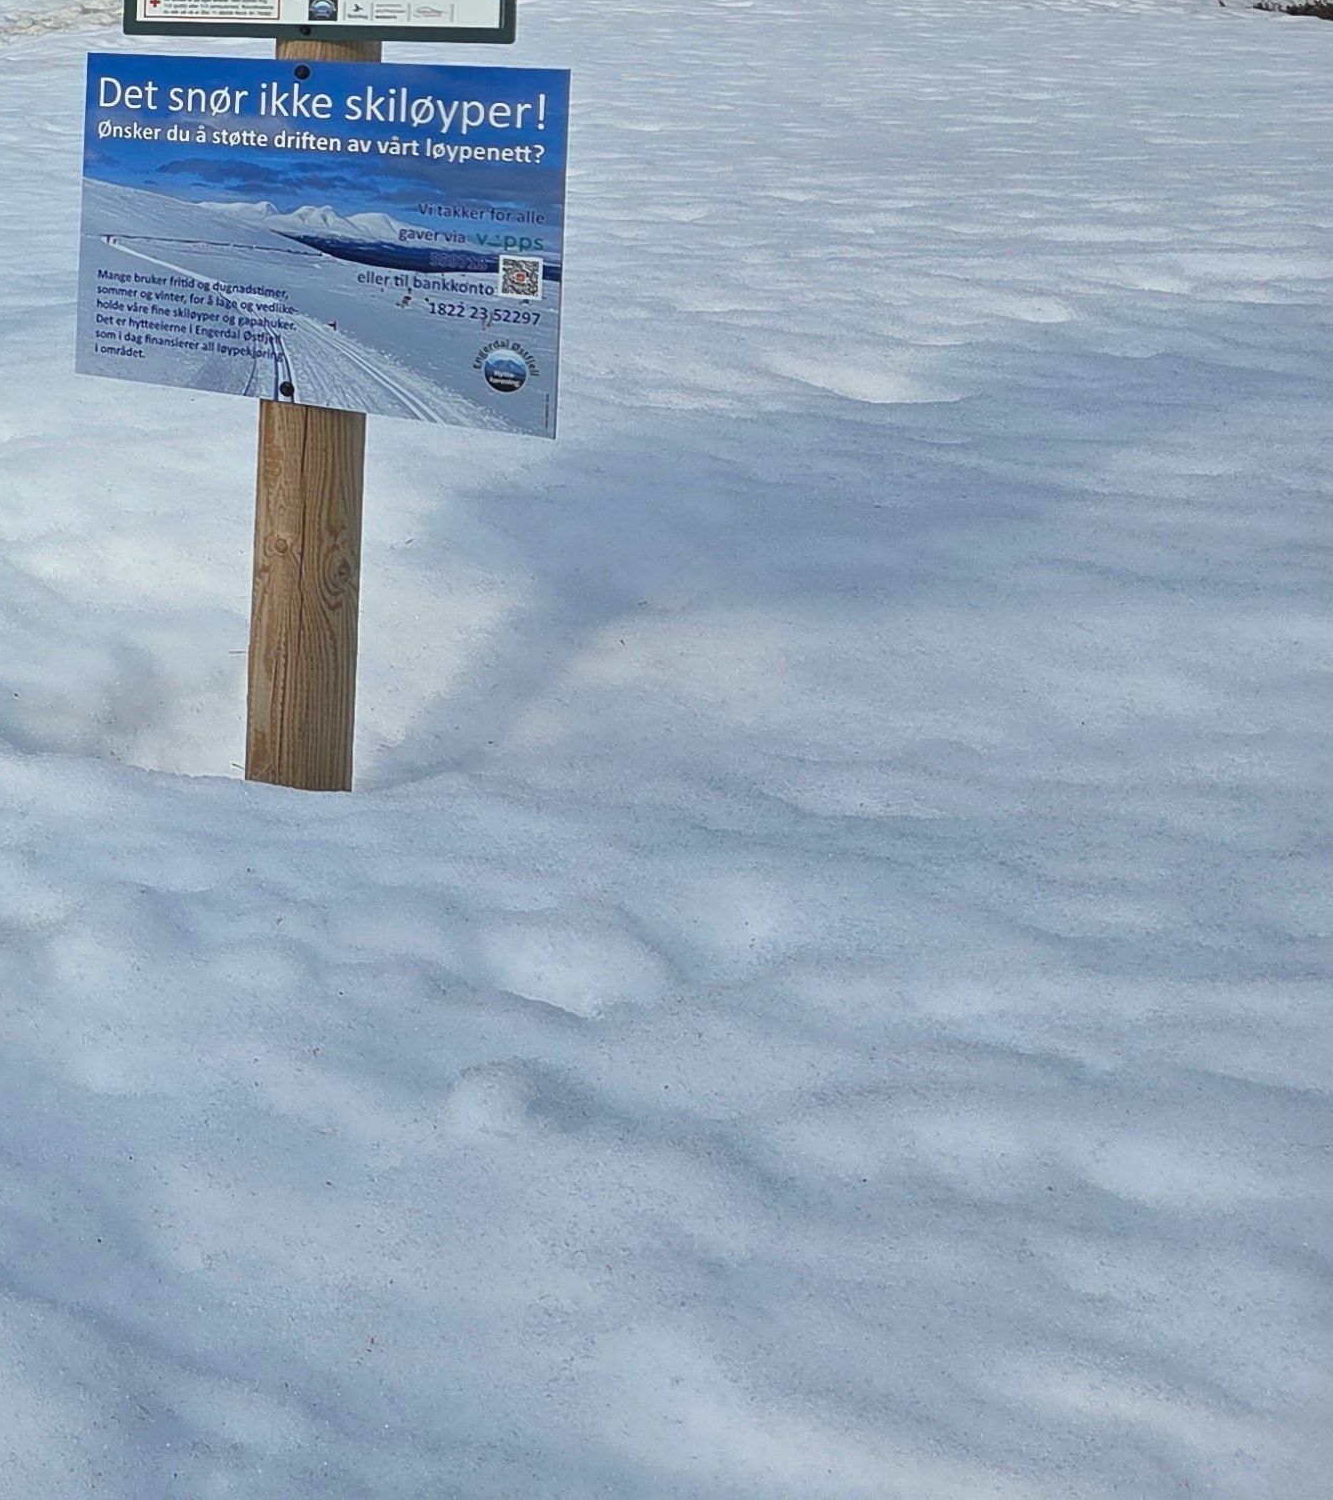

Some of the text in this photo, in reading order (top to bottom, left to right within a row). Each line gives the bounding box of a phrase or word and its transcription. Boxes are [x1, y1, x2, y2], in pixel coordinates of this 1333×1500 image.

[98, 76, 546, 135] Det snør ikke skiløyper!
[97, 118, 545, 164] Ønsker du å støtte driften av vårt løypenett?
[418, 203, 545, 225] Vi takker for alle
[398, 228, 440, 242] gaver
[444, 231, 466, 244] via
[98, 269, 289, 300] Mange bruker fritid og dugnadstimer,
[357, 271, 390, 287] eller
[394, 274, 409, 287] til
[97, 286, 138, 297] sommer
[140, 290, 153, 301] og
[155, 290, 187, 304] vinter,
[189, 293, 204, 304] for
[207, 295, 213, 305] å
[216, 296, 238, 309] lage
[240, 302, 253, 312] og
[96, 299, 297, 331] holde våre fine skiløyper og gapahuker.
[96, 314, 114, 325] Det
[116, 318, 126, 326] er
[128, 317, 187, 332] hytteeierne
[195, 325, 240, 339] Engerdal
[429, 302, 541, 326] 1822 23 52297
[95, 330, 116, 339] som
[124, 332, 143, 345] dag
[145, 334, 199, 350] finansierer
[202, 342, 214, 351] all
[100, 345, 146, 358] området.
[473, 339, 540, 377] Engerdal Østfjell
